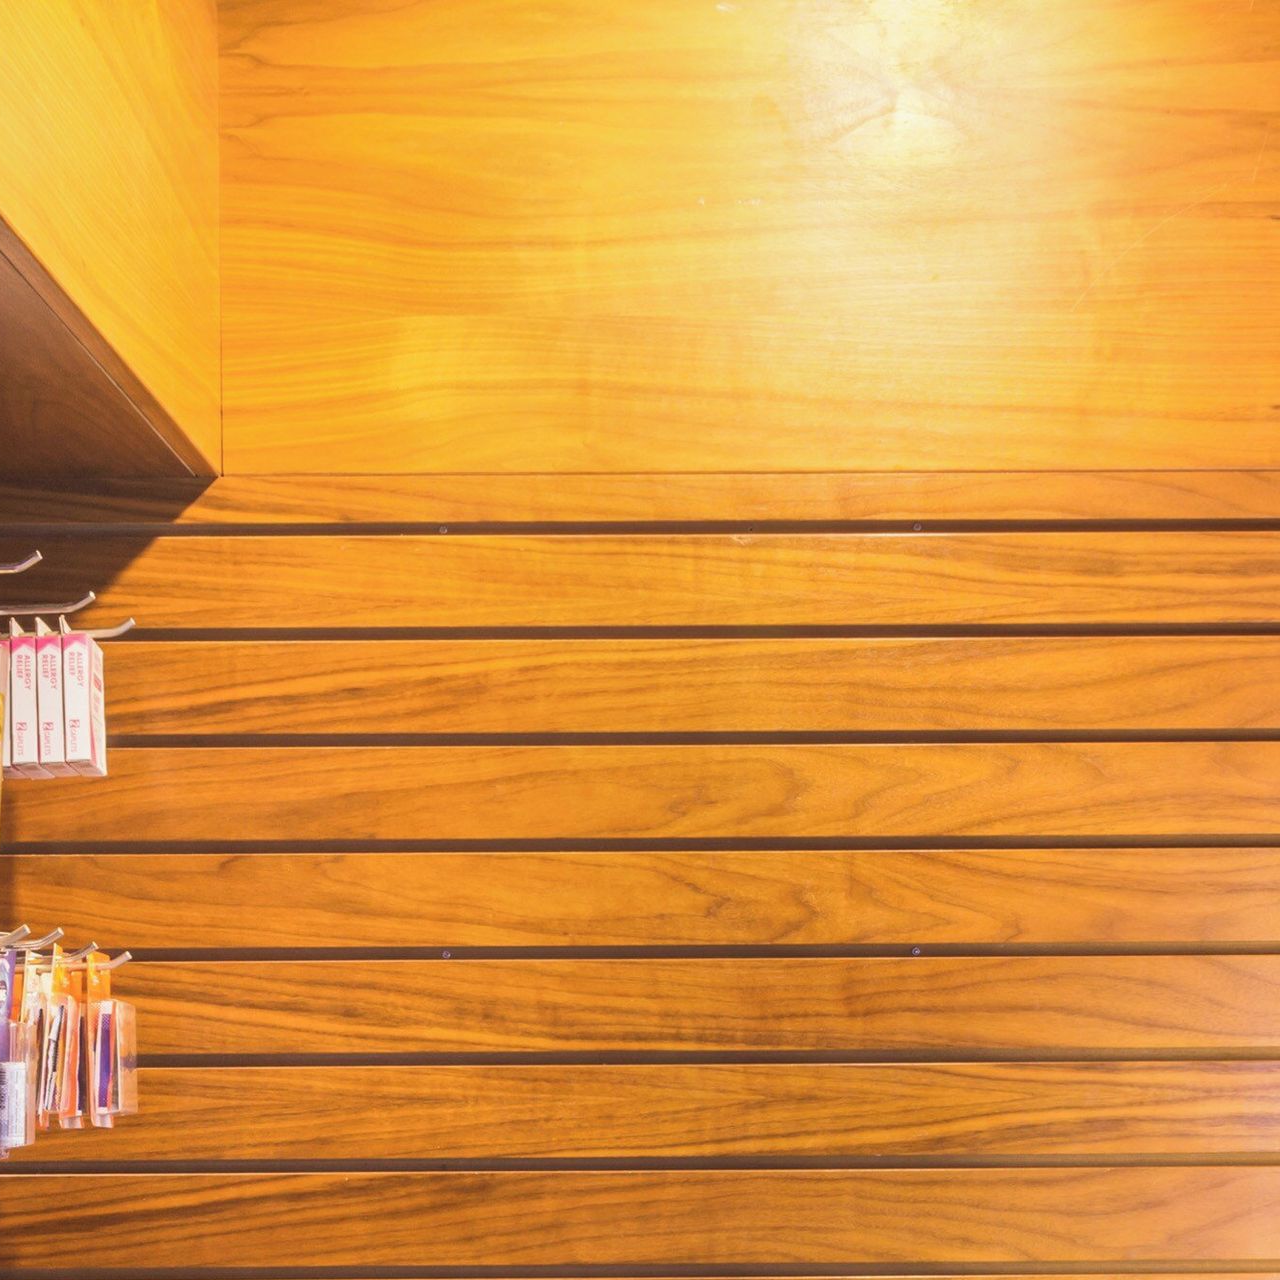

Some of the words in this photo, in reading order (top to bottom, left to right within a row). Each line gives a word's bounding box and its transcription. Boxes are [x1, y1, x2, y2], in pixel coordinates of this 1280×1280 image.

[16, 654, 24, 679] RELIEF
[23, 654, 32, 690] ALLERGY
[41, 654, 49, 679] RELIEF
[48, 654, 58, 690] ALLERGY
[68, 651, 76, 677] RELIEF
[75, 651, 84, 687] ALLERGY
